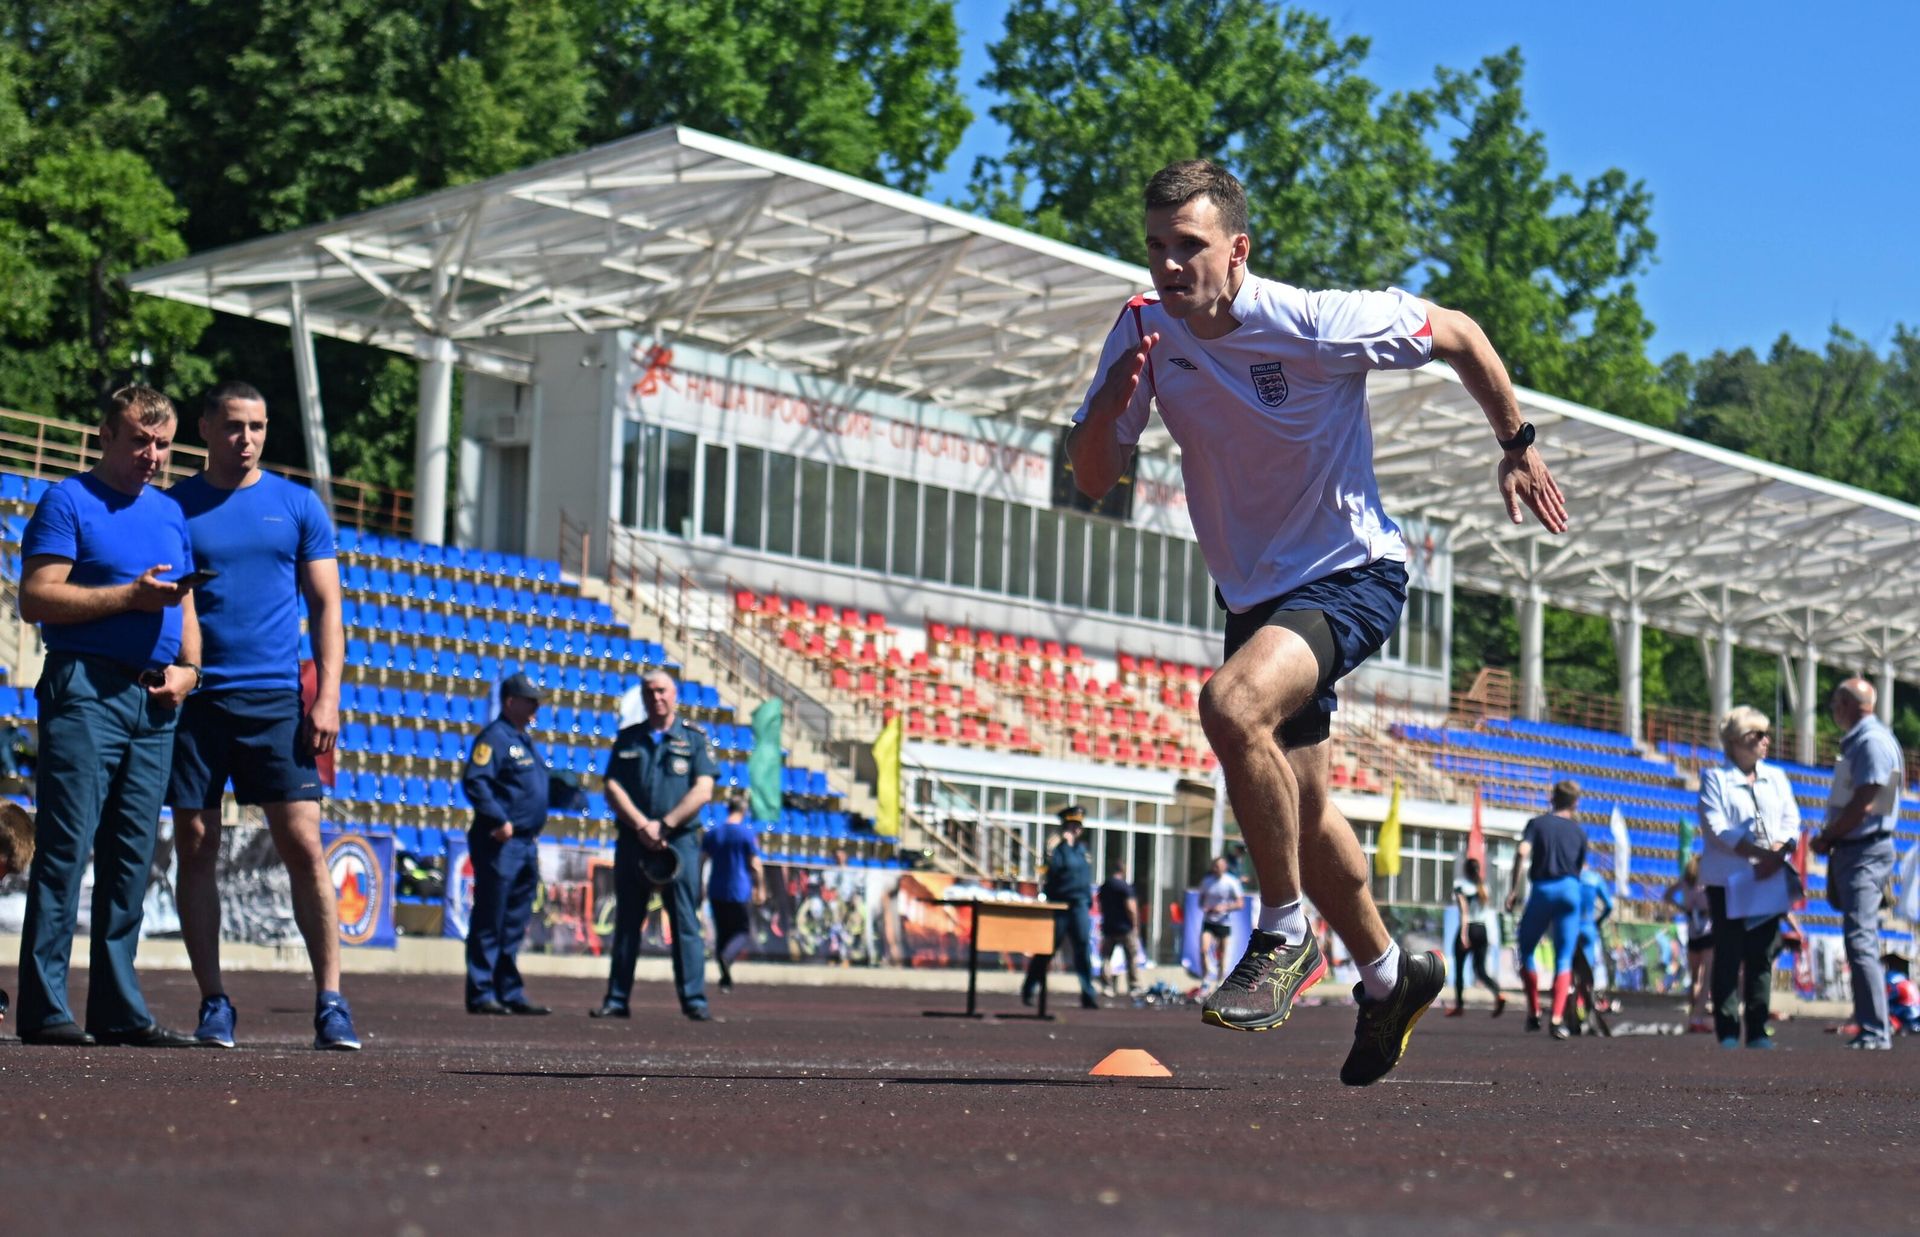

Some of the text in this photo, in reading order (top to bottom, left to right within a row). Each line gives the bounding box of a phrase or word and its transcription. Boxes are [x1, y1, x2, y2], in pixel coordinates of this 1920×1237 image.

[1252, 363, 1280, 372] ENGLAND
[687, 372, 748, 412] НАША
[753, 385, 872, 438] ПРОФЕССИЯ
